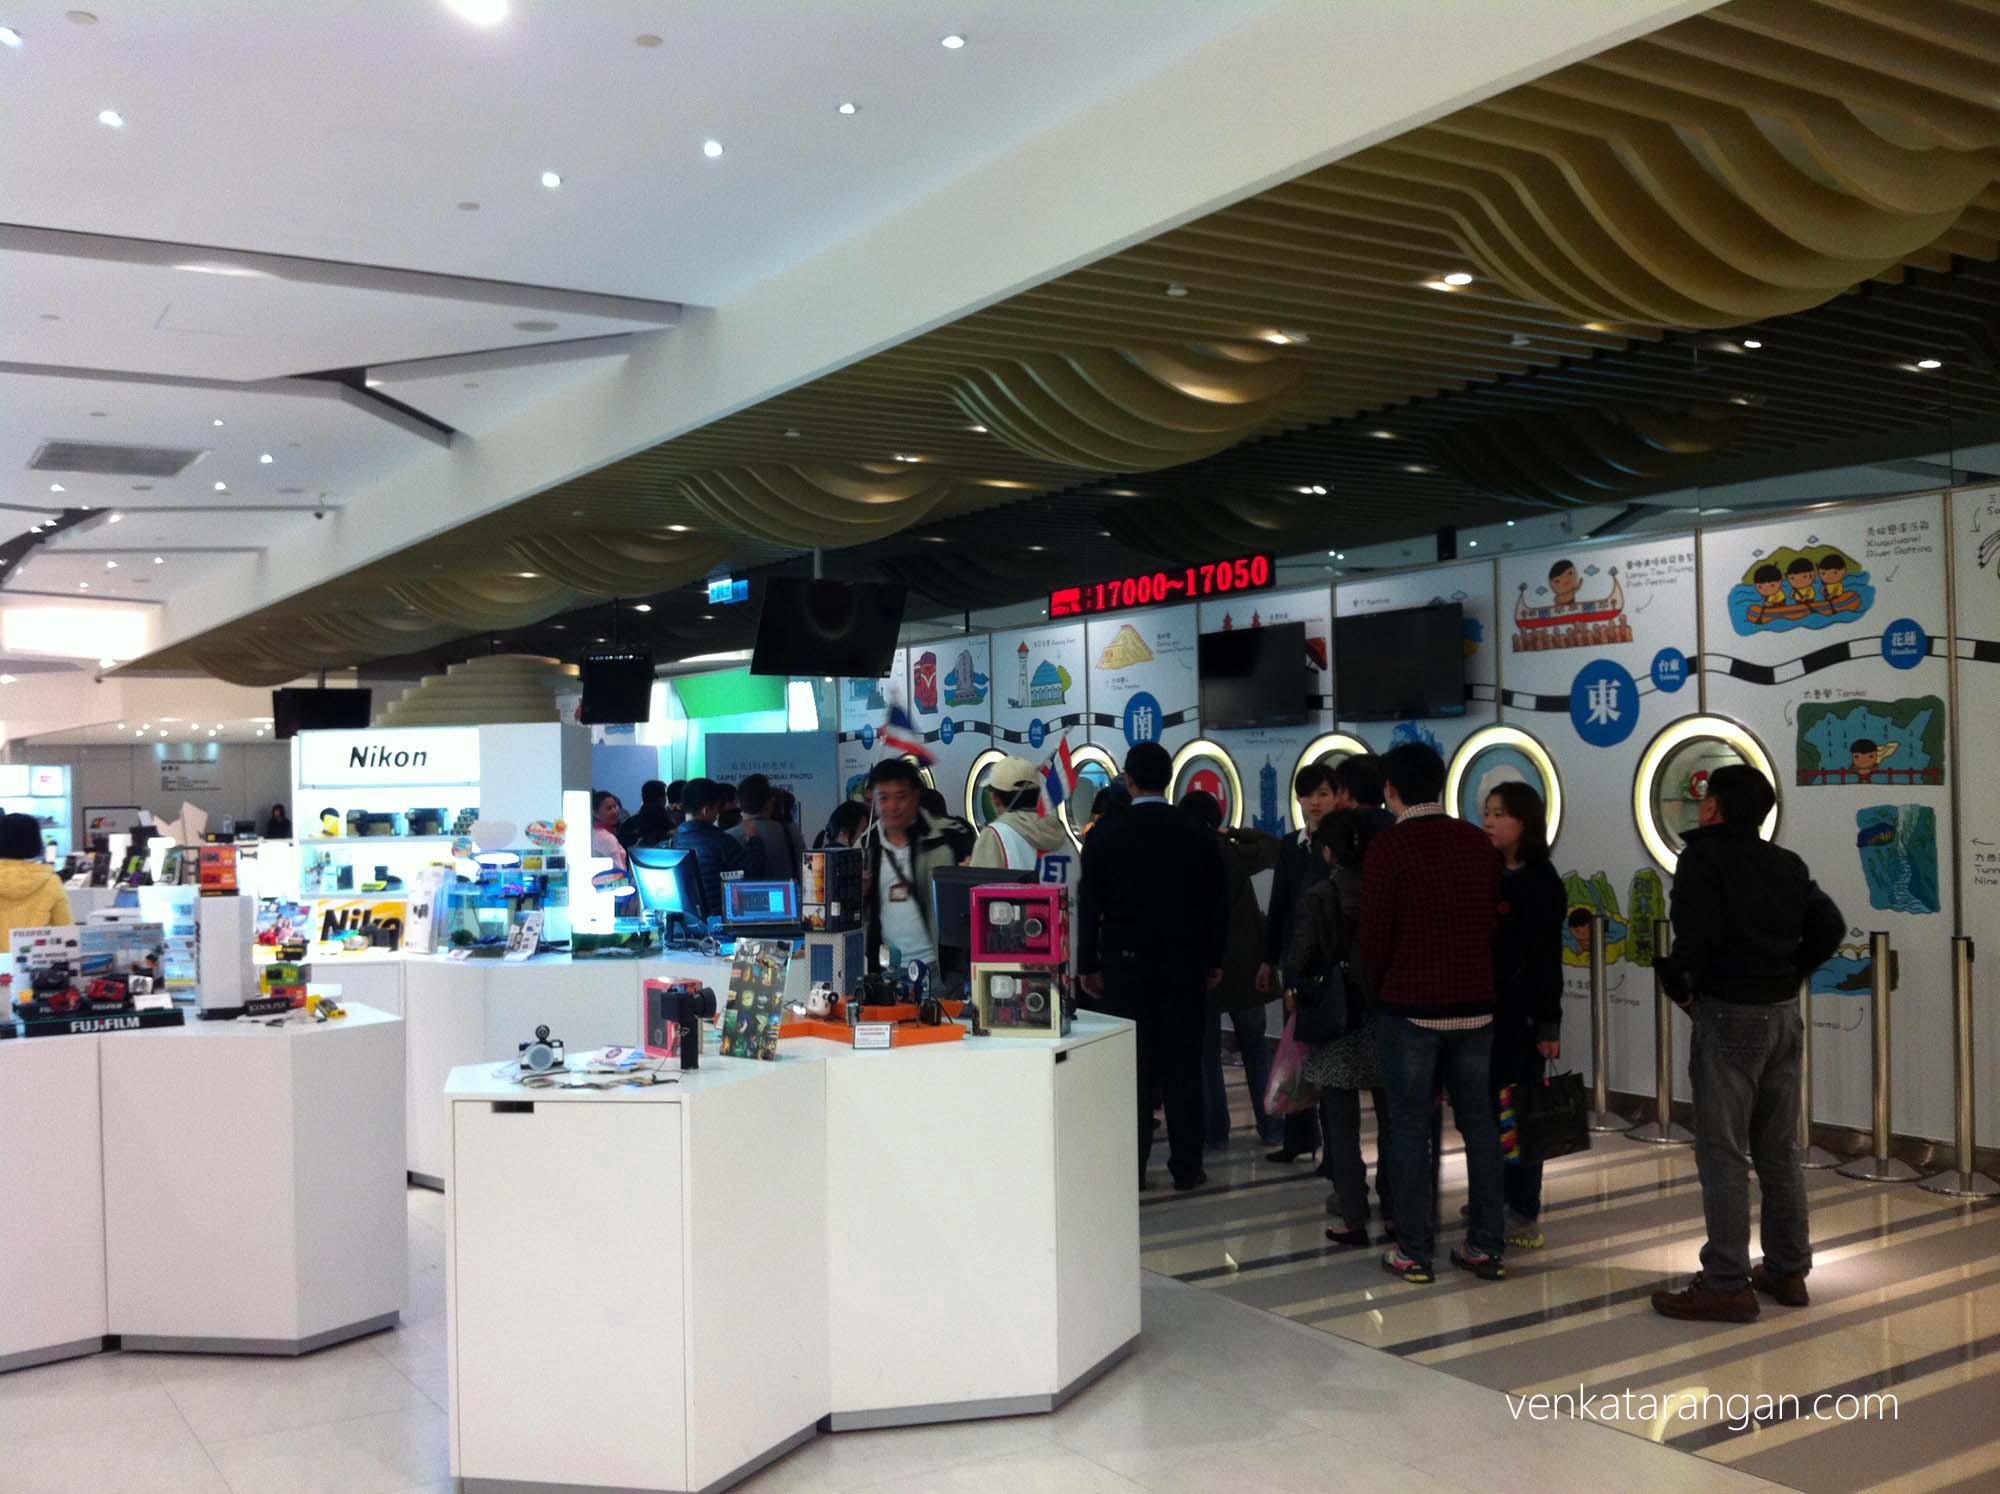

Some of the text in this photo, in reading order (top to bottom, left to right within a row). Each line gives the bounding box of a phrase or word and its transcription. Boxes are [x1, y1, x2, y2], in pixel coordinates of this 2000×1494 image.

[1584, 679, 1622, 725] 東
[1132, 706, 1153, 740] 南
[349, 745, 427, 768] Nikon
[71, 1017, 140, 1033] FUJIFILM
